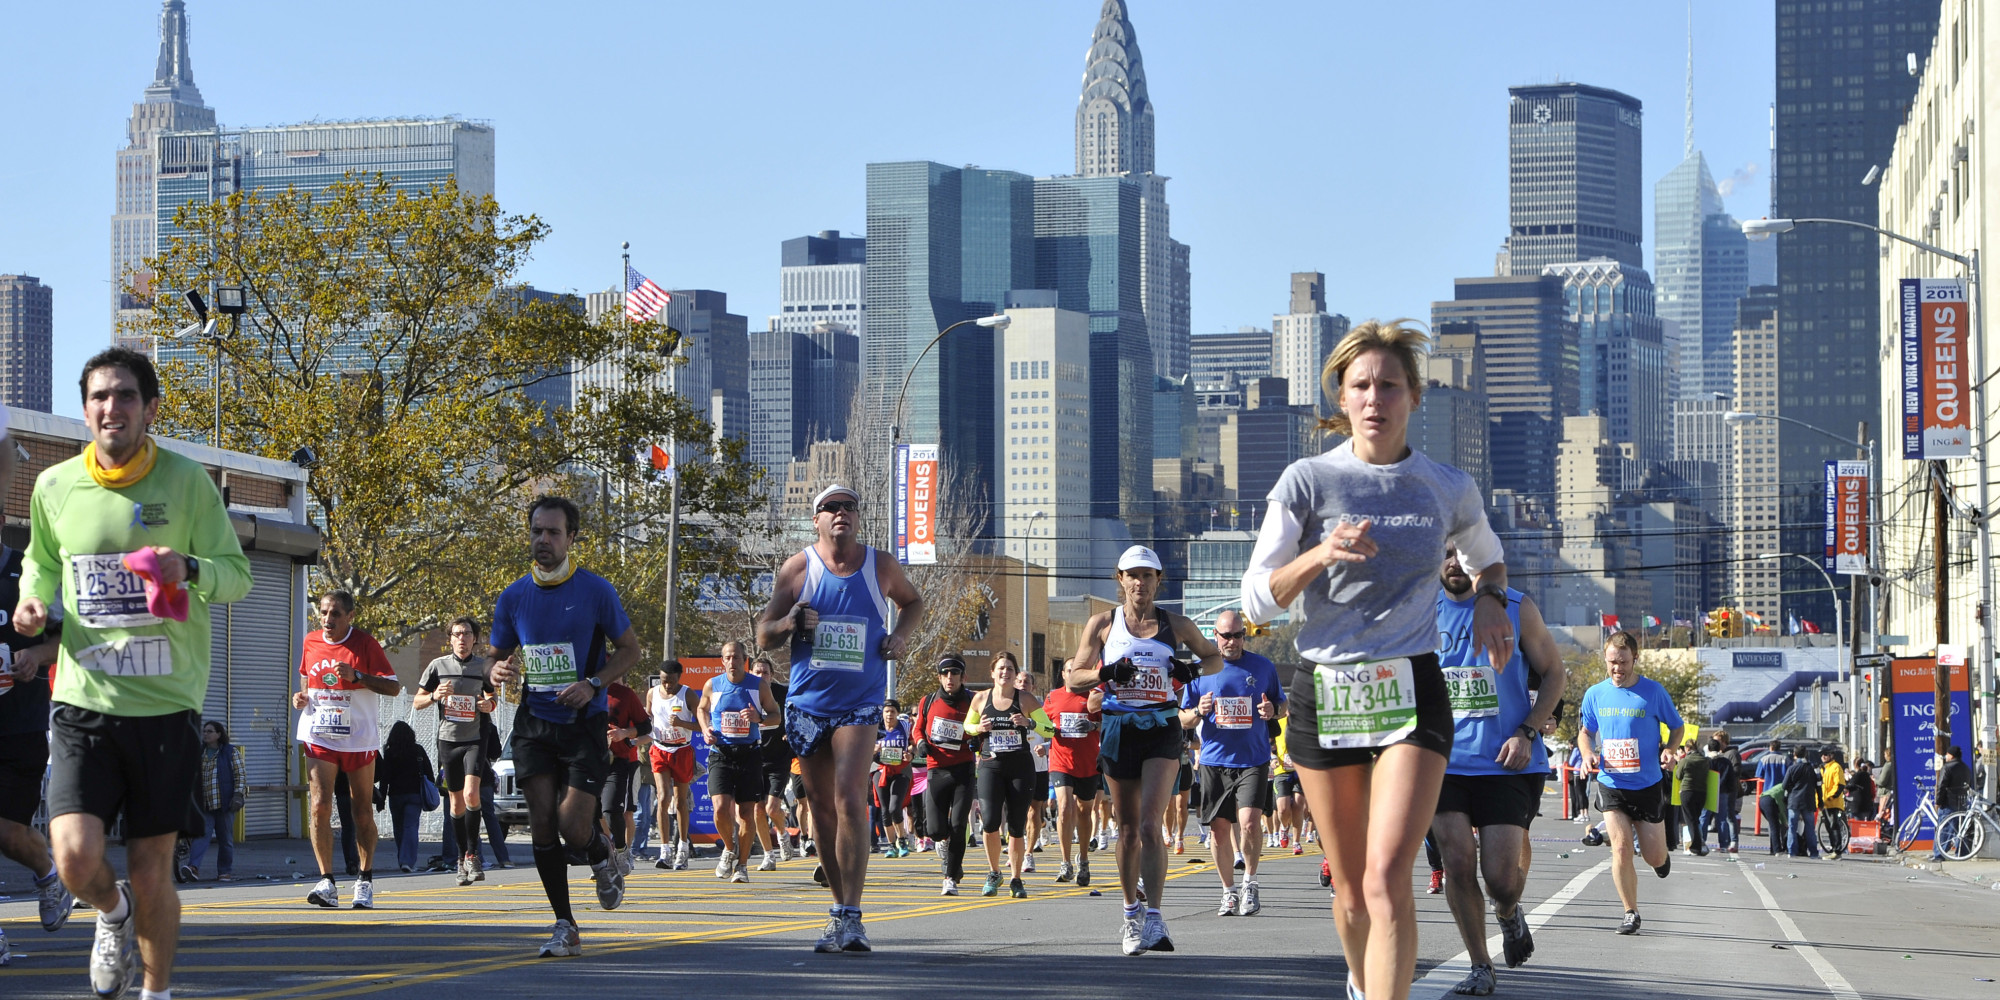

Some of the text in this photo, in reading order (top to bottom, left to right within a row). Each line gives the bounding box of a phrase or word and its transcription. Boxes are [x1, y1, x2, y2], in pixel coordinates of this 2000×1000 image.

[1926, 290, 1962, 299] 2011
[1904, 285, 1919, 453] THE ING NEW YORK CITY MARATHON
[1934, 307, 1959, 421] QUEENS
[898, 485, 906, 500] CITY
[914, 463, 931, 539] QUEENS
[898, 501, 906, 518] YORK
[1844, 479, 1859, 551] QUEENS
[898, 519, 906, 534] NEW
[1383, 515, 1402, 526] TO
[1403, 515, 1434, 527] RUN
[898, 547, 906, 560] THE
[87, 559, 119, 572] ING
[824, 625, 844, 633] ING
[819, 633, 859, 650] 19-631
[97, 639, 167, 675] MATT
[531, 648, 551, 656] ING
[528, 655, 570, 672] 20-048
[1335, 670, 1370, 683] ING
[1446, 671, 1468, 679] ING
[1330, 680, 1402, 711] 17-344
[1220, 705, 1247, 715] 15-780
[1599, 707, 1619, 717] ROBIN
[1903, 704, 1935, 716] ING
[320, 714, 342, 725] 8-141
[1322, 720, 1375, 728] MARATHON
[993, 736, 1019, 745] 49-948
[1608, 748, 1636, 759] 32-943
